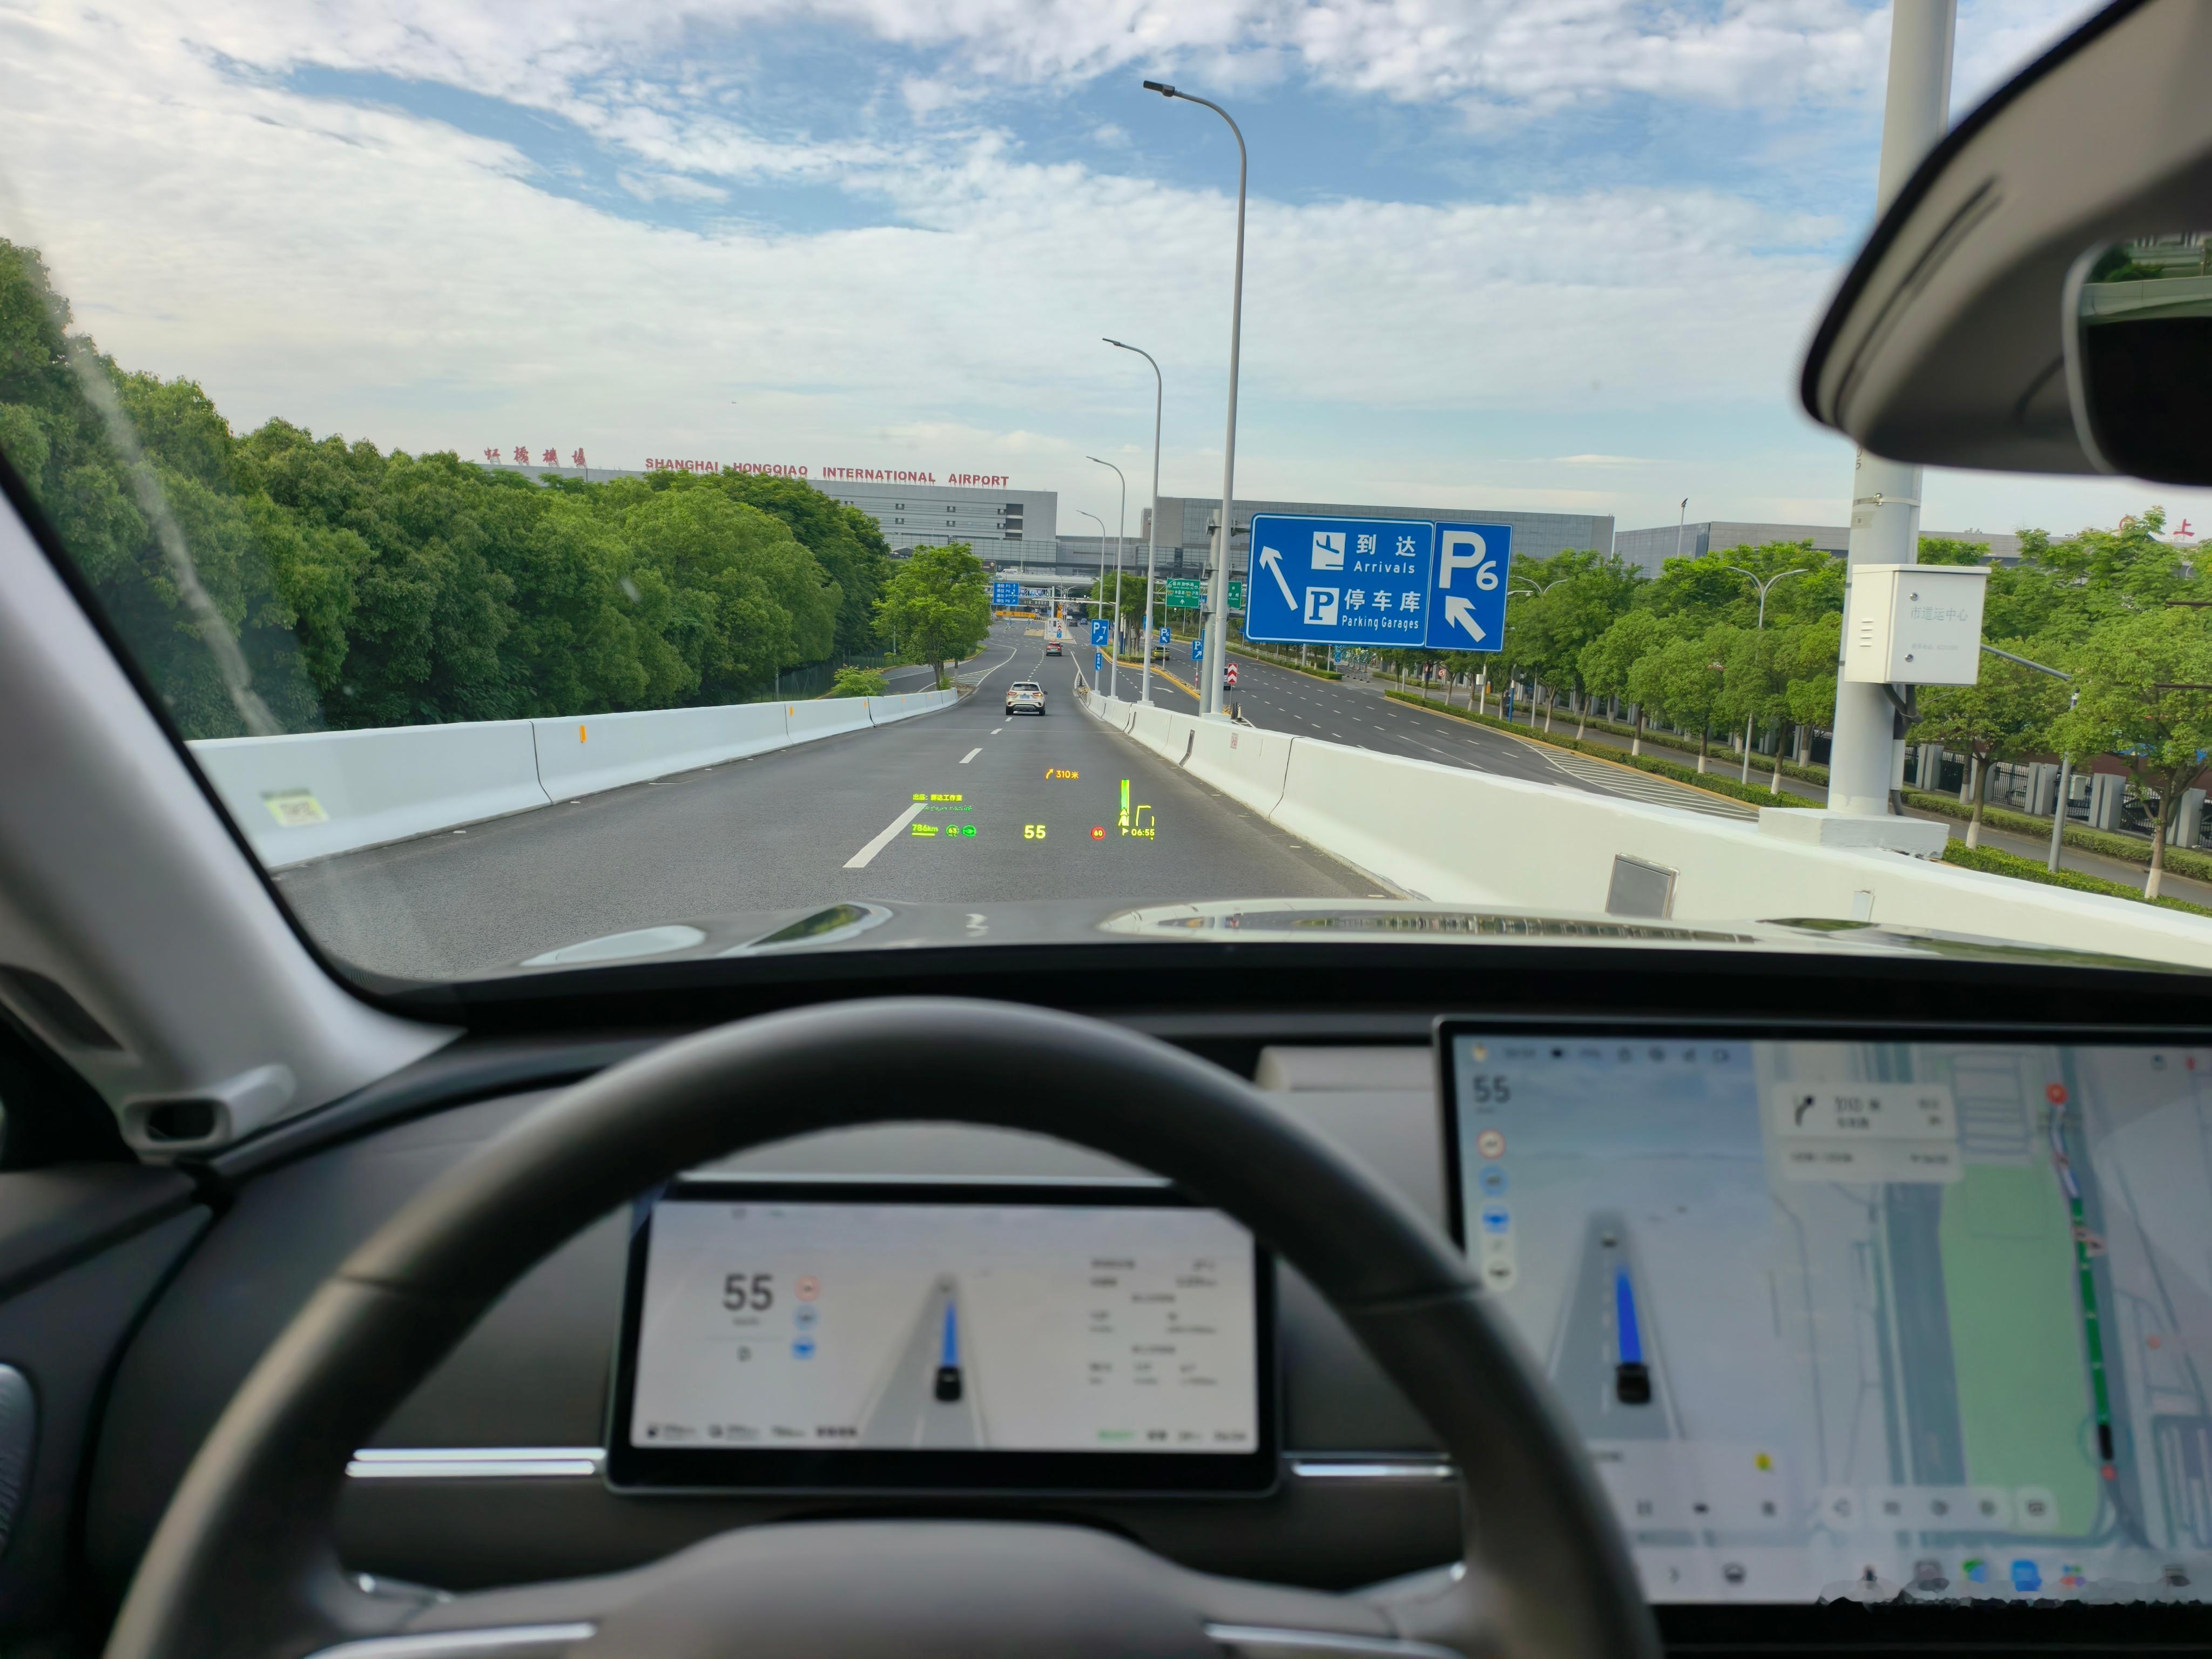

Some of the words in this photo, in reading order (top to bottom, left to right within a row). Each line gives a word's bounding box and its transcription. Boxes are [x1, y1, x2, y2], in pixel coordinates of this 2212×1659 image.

[645, 458, 719, 471] SHANGHAI
[733, 462, 808, 476] HONGQIAO
[823, 467, 936, 483] INTERNATIONAL
[948, 474, 1009, 488] AIRPORT
[2173, 518, 2195, 537] 上
[1356, 534, 1416, 557] 到达
[1354, 561, 1415, 574] Arrivals
[1439, 530, 1499, 591] P6
[1344, 589, 1421, 613] 停车库
[1342, 615, 1379, 630] Parking
[1381, 618, 1419, 631] Garages
[912, 824, 938, 832] 786km
[1024, 825, 1046, 839] 55
[1473, 1075, 1510, 1104] 55
[723, 1273, 774, 1311] 55
